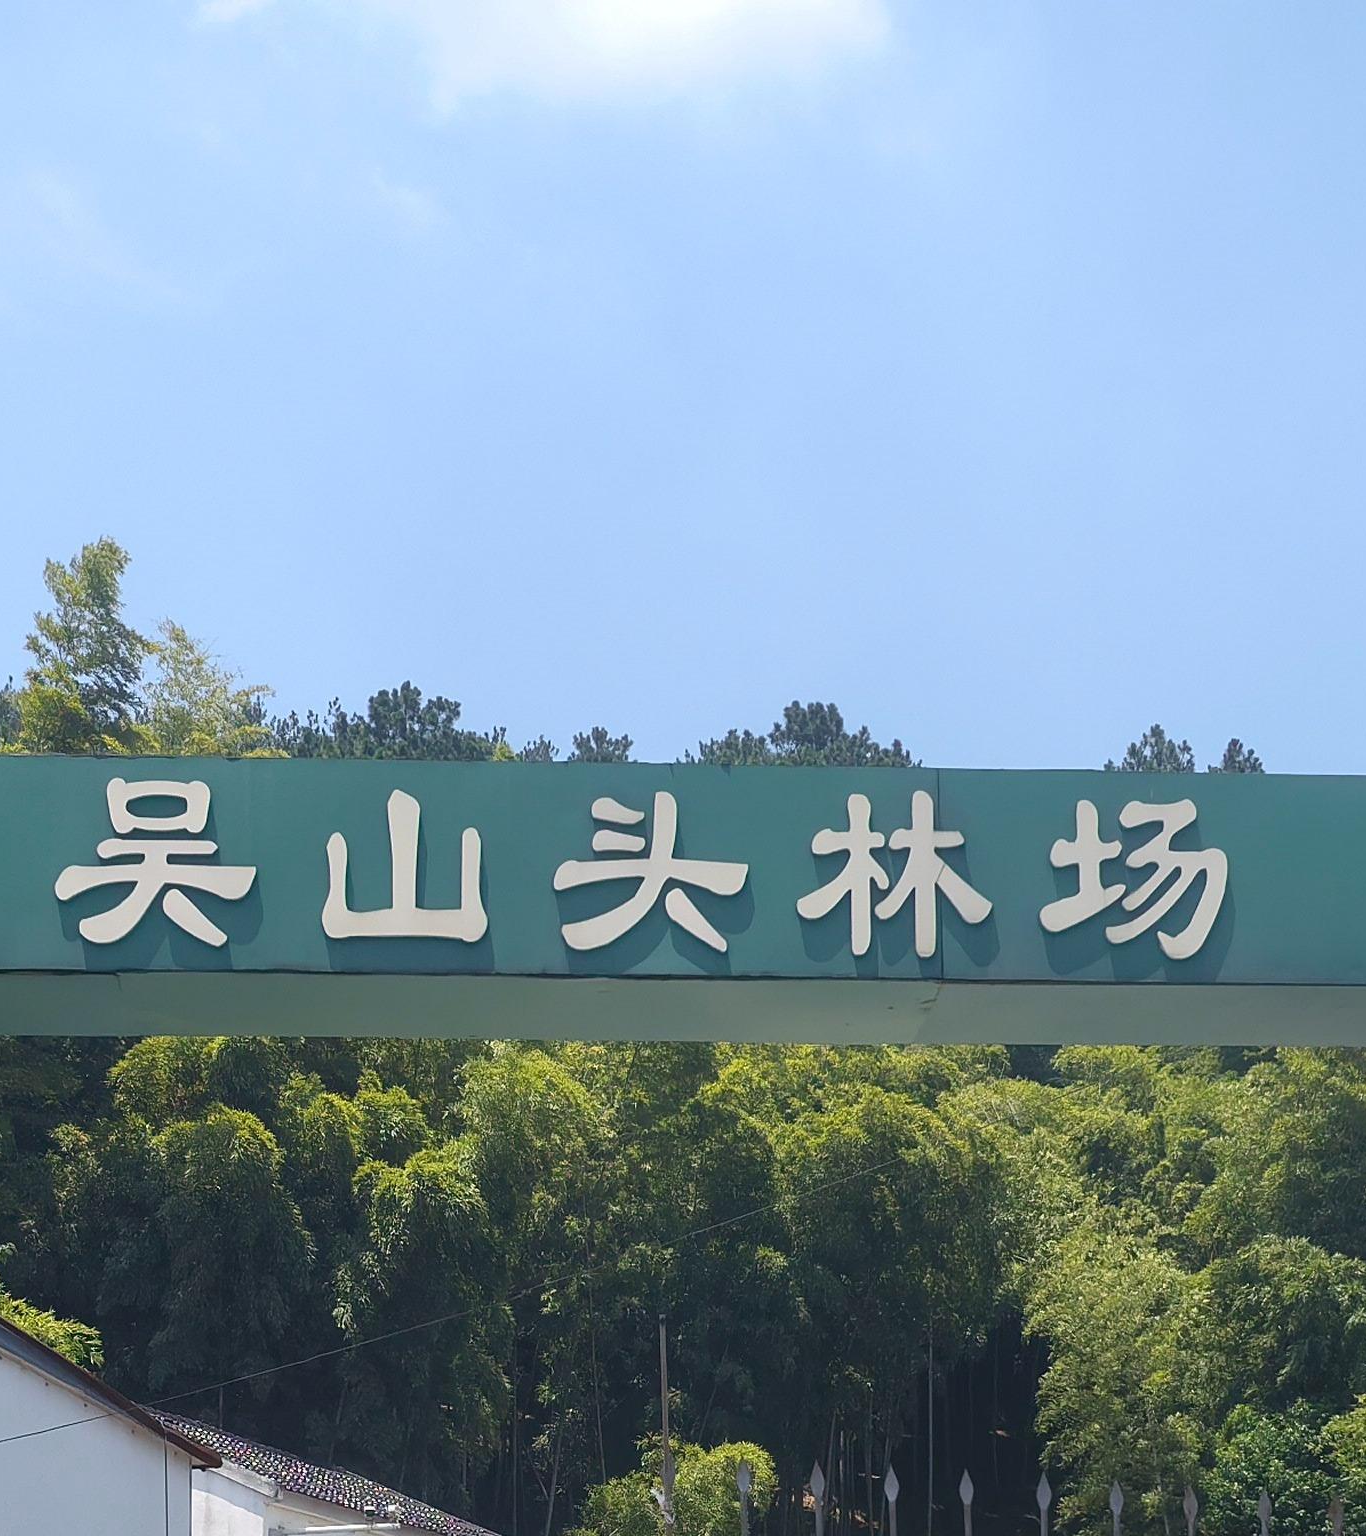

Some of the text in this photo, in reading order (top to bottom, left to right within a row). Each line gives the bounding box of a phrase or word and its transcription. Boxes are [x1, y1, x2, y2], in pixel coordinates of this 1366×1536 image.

[54, 777, 1228, 960] 吴山头林场
